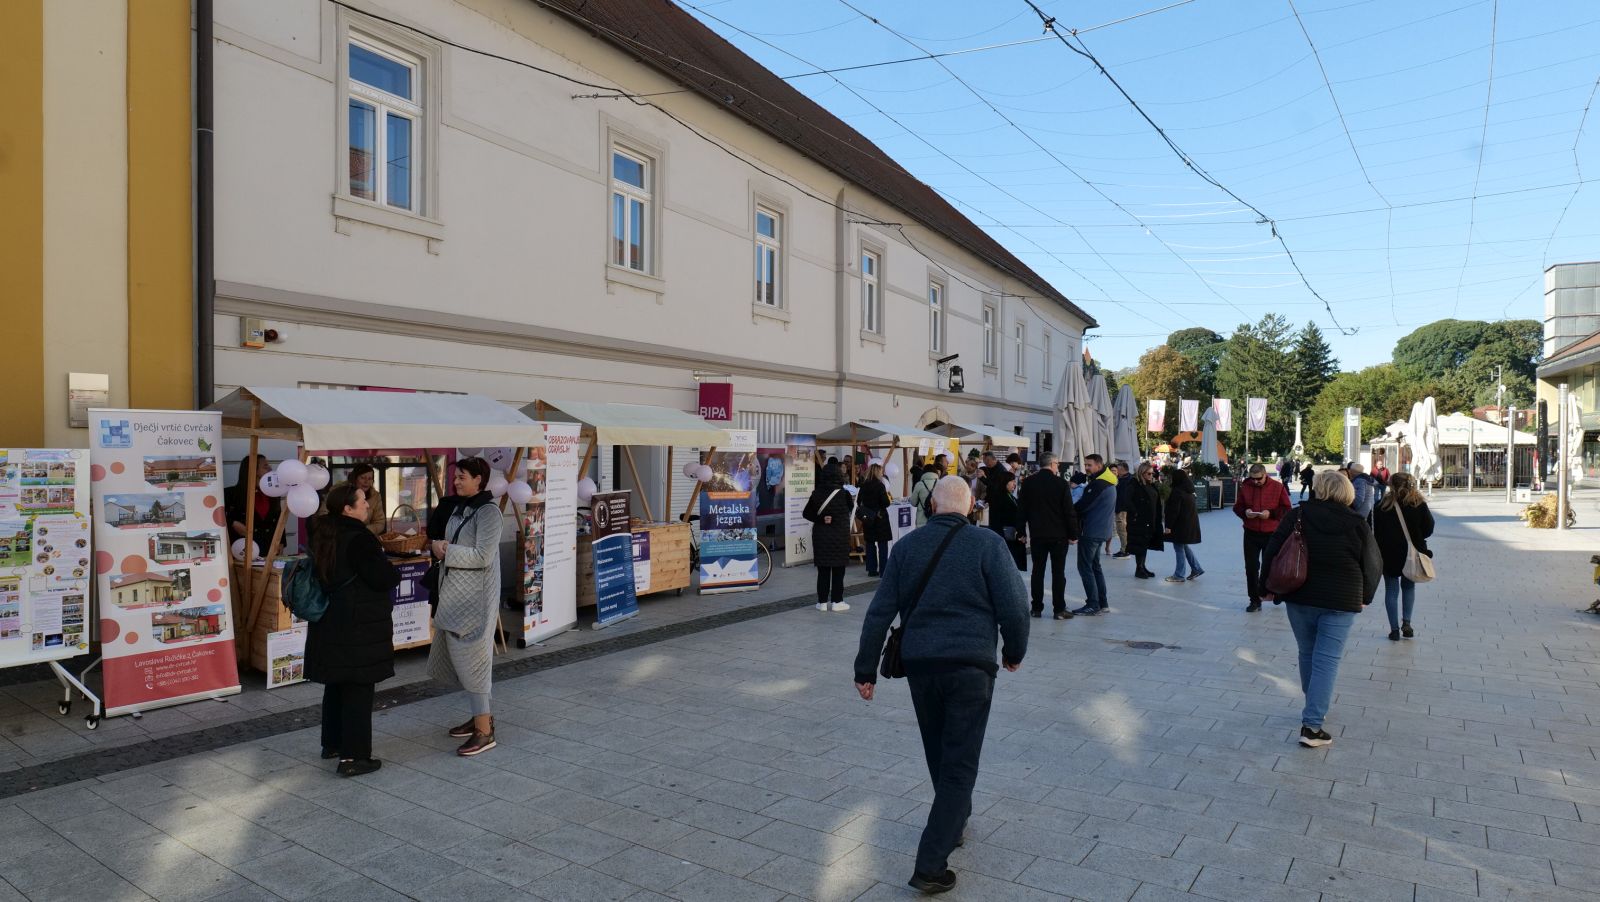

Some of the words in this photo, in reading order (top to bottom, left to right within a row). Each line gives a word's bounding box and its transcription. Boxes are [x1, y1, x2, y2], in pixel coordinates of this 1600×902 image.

[700, 406, 727, 419] BIPA
[134, 422, 159, 433] Dječji
[161, 423, 182, 432] vrtić
[184, 423, 214, 433] Cvrčak
[157, 435, 194, 446] Čakovec
[709, 503, 750, 515] Metalska
[716, 514, 743, 527] jezgra
